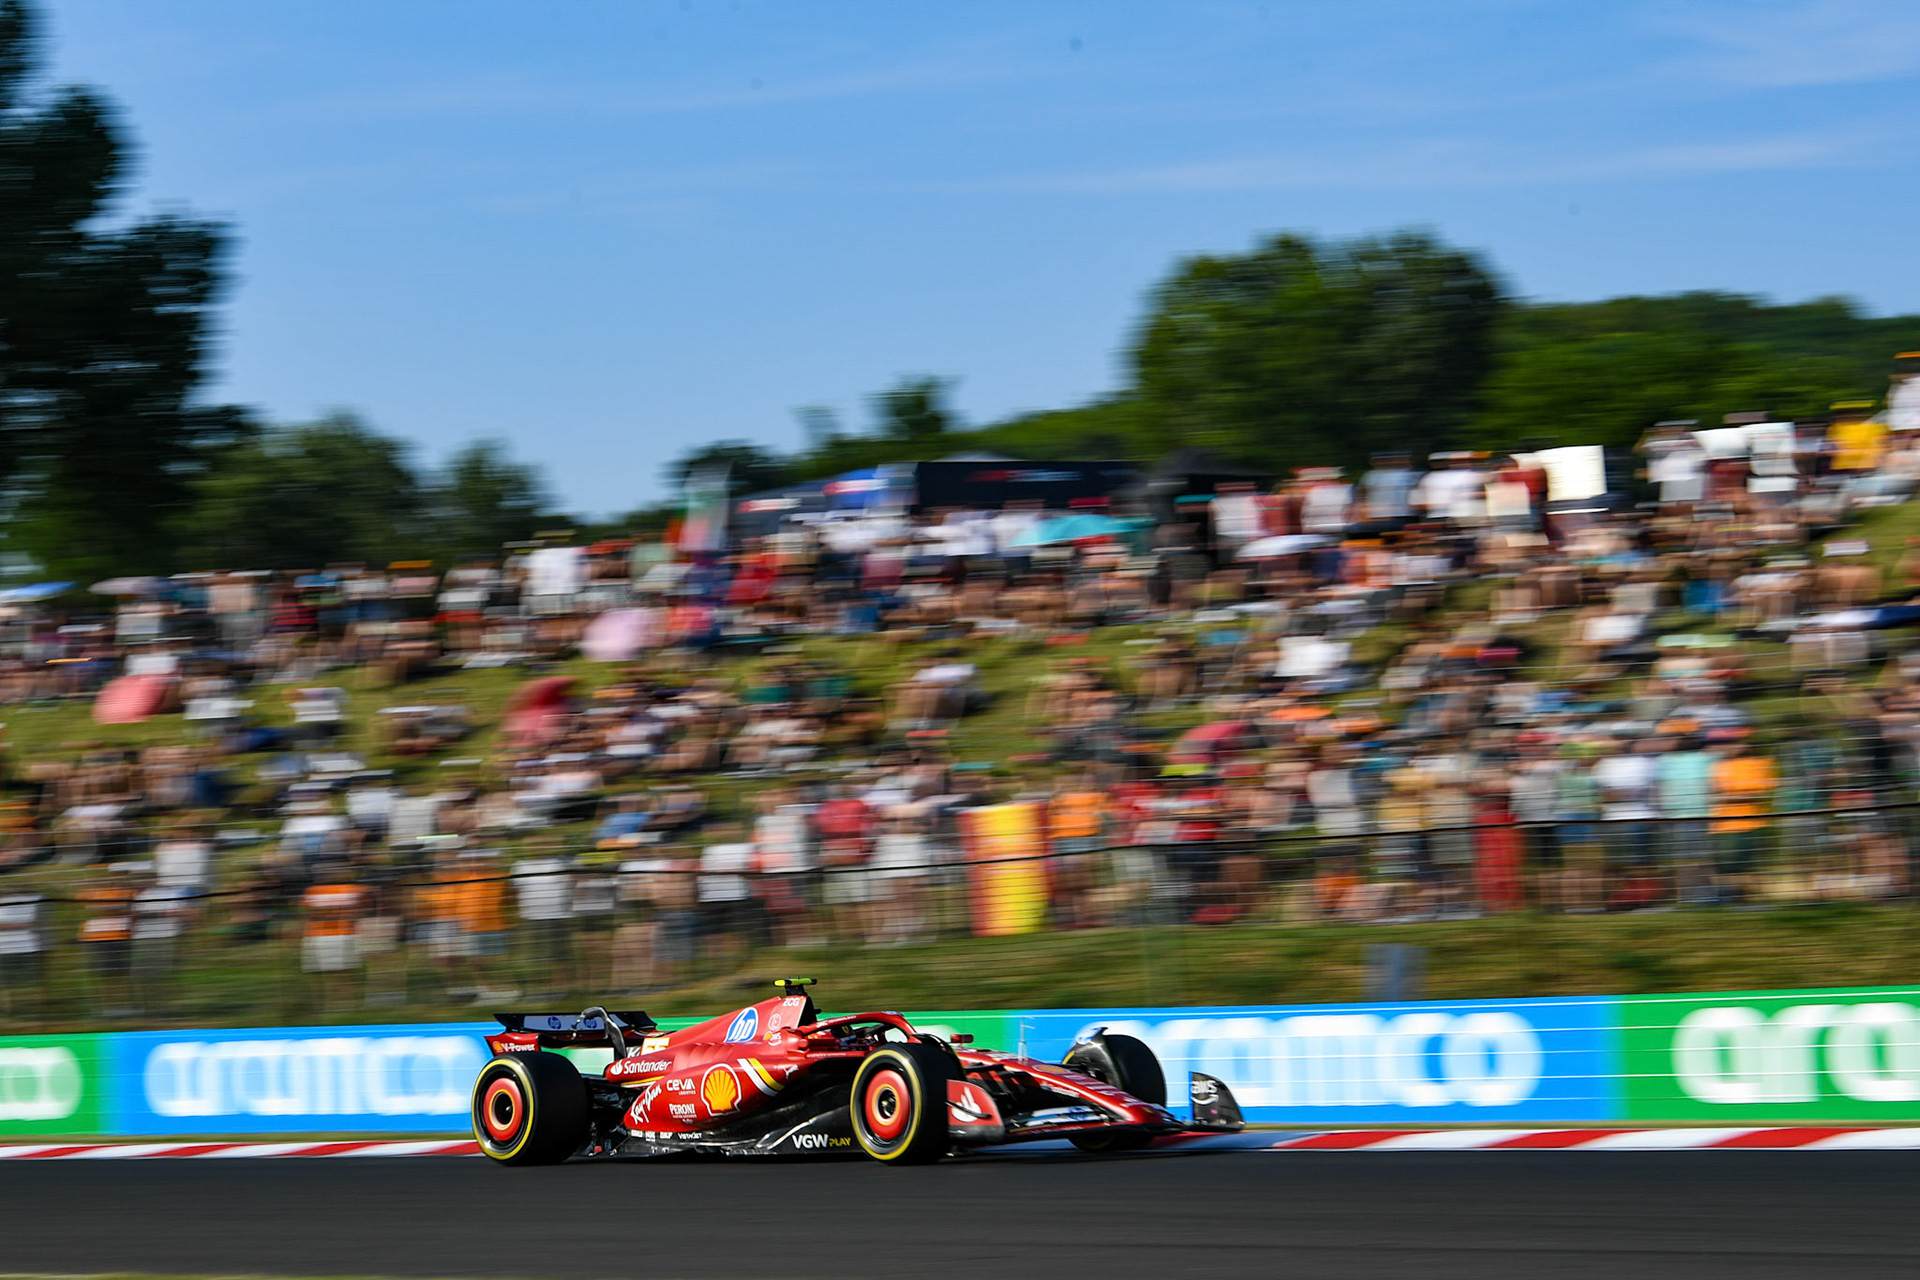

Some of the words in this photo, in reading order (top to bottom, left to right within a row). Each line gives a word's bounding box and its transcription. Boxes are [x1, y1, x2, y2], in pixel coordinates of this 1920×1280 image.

[727, 1011, 757, 1042] hp
[503, 1042, 535, 1053] V-Power
[624, 1060, 672, 1075] Santander
[1190, 1079, 1217, 1094] aws
[669, 1103, 696, 1115] PERONI
[792, 1133, 829, 1149] VGW
[829, 1137, 851, 1147] PLAY
